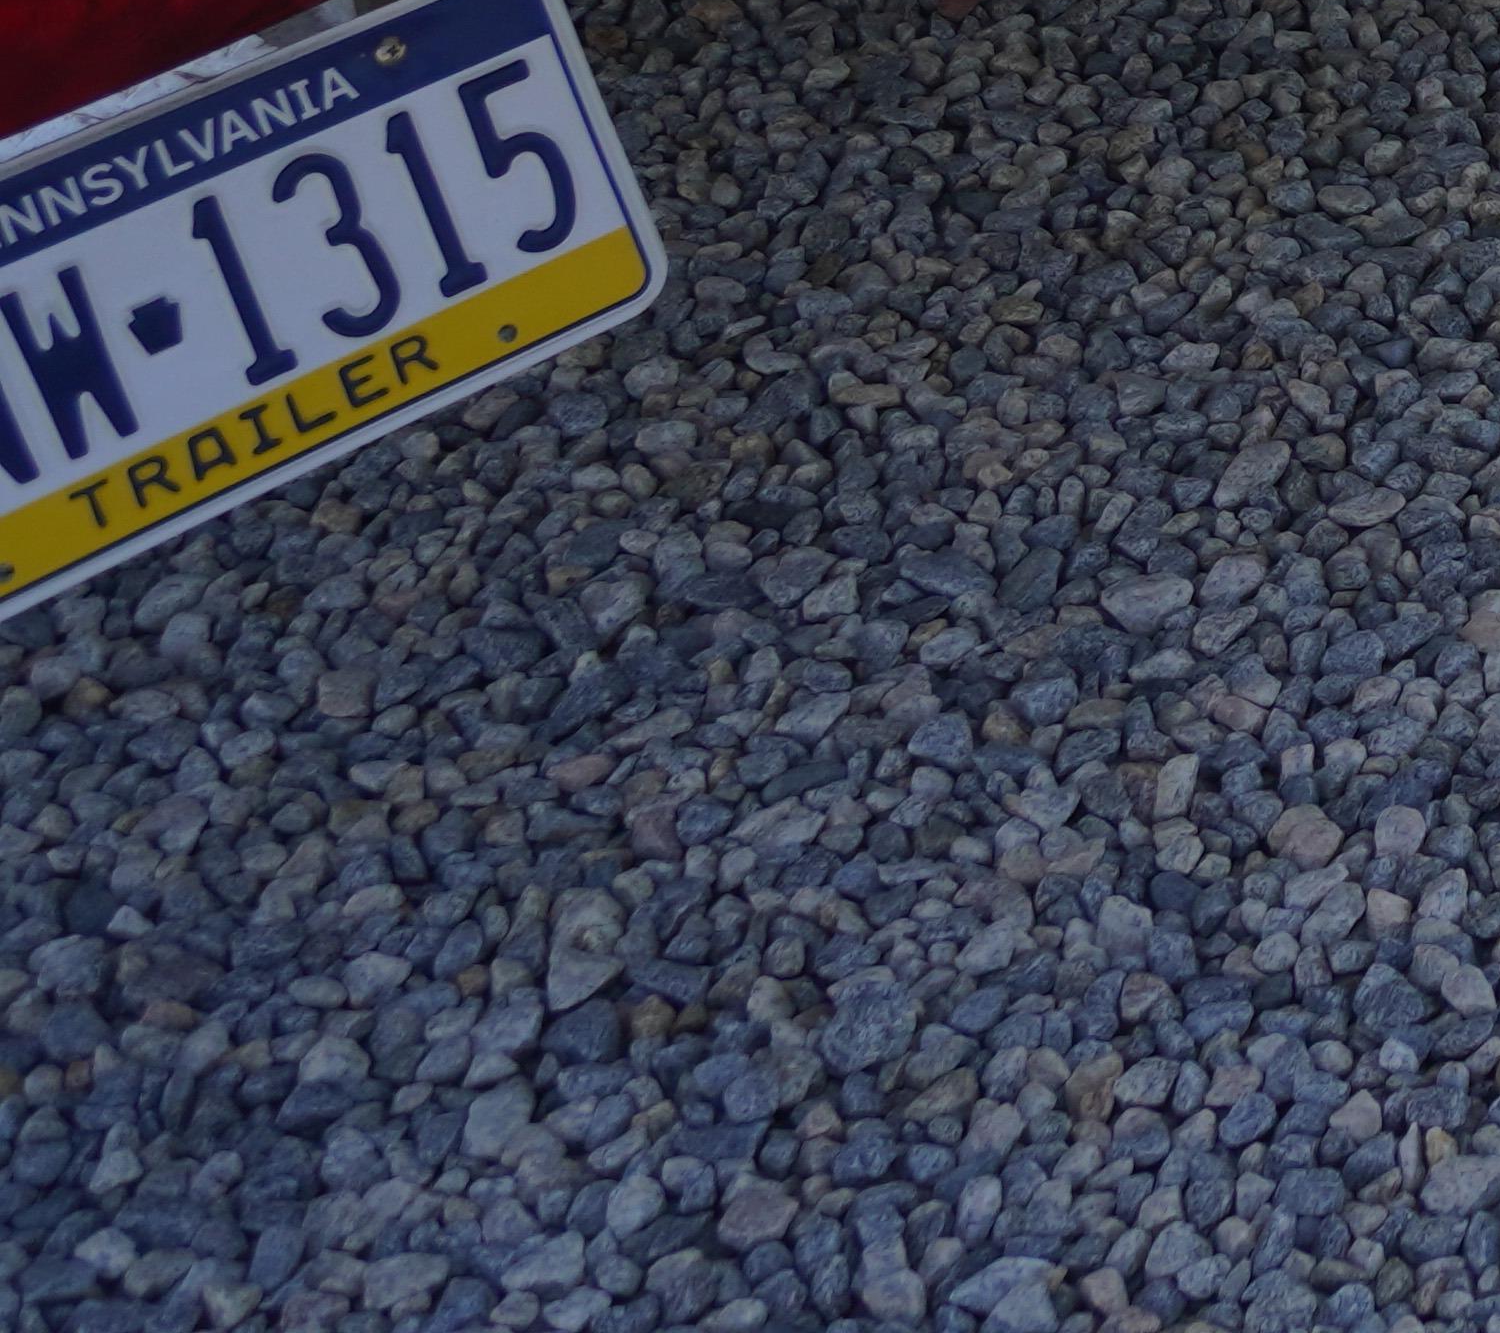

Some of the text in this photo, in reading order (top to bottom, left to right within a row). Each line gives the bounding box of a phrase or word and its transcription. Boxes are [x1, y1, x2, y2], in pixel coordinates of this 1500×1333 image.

[0, 67, 361, 247] NNSYLVANIA
[191, 58, 578, 387] 1315
[69, 334, 440, 529] TRAILER
